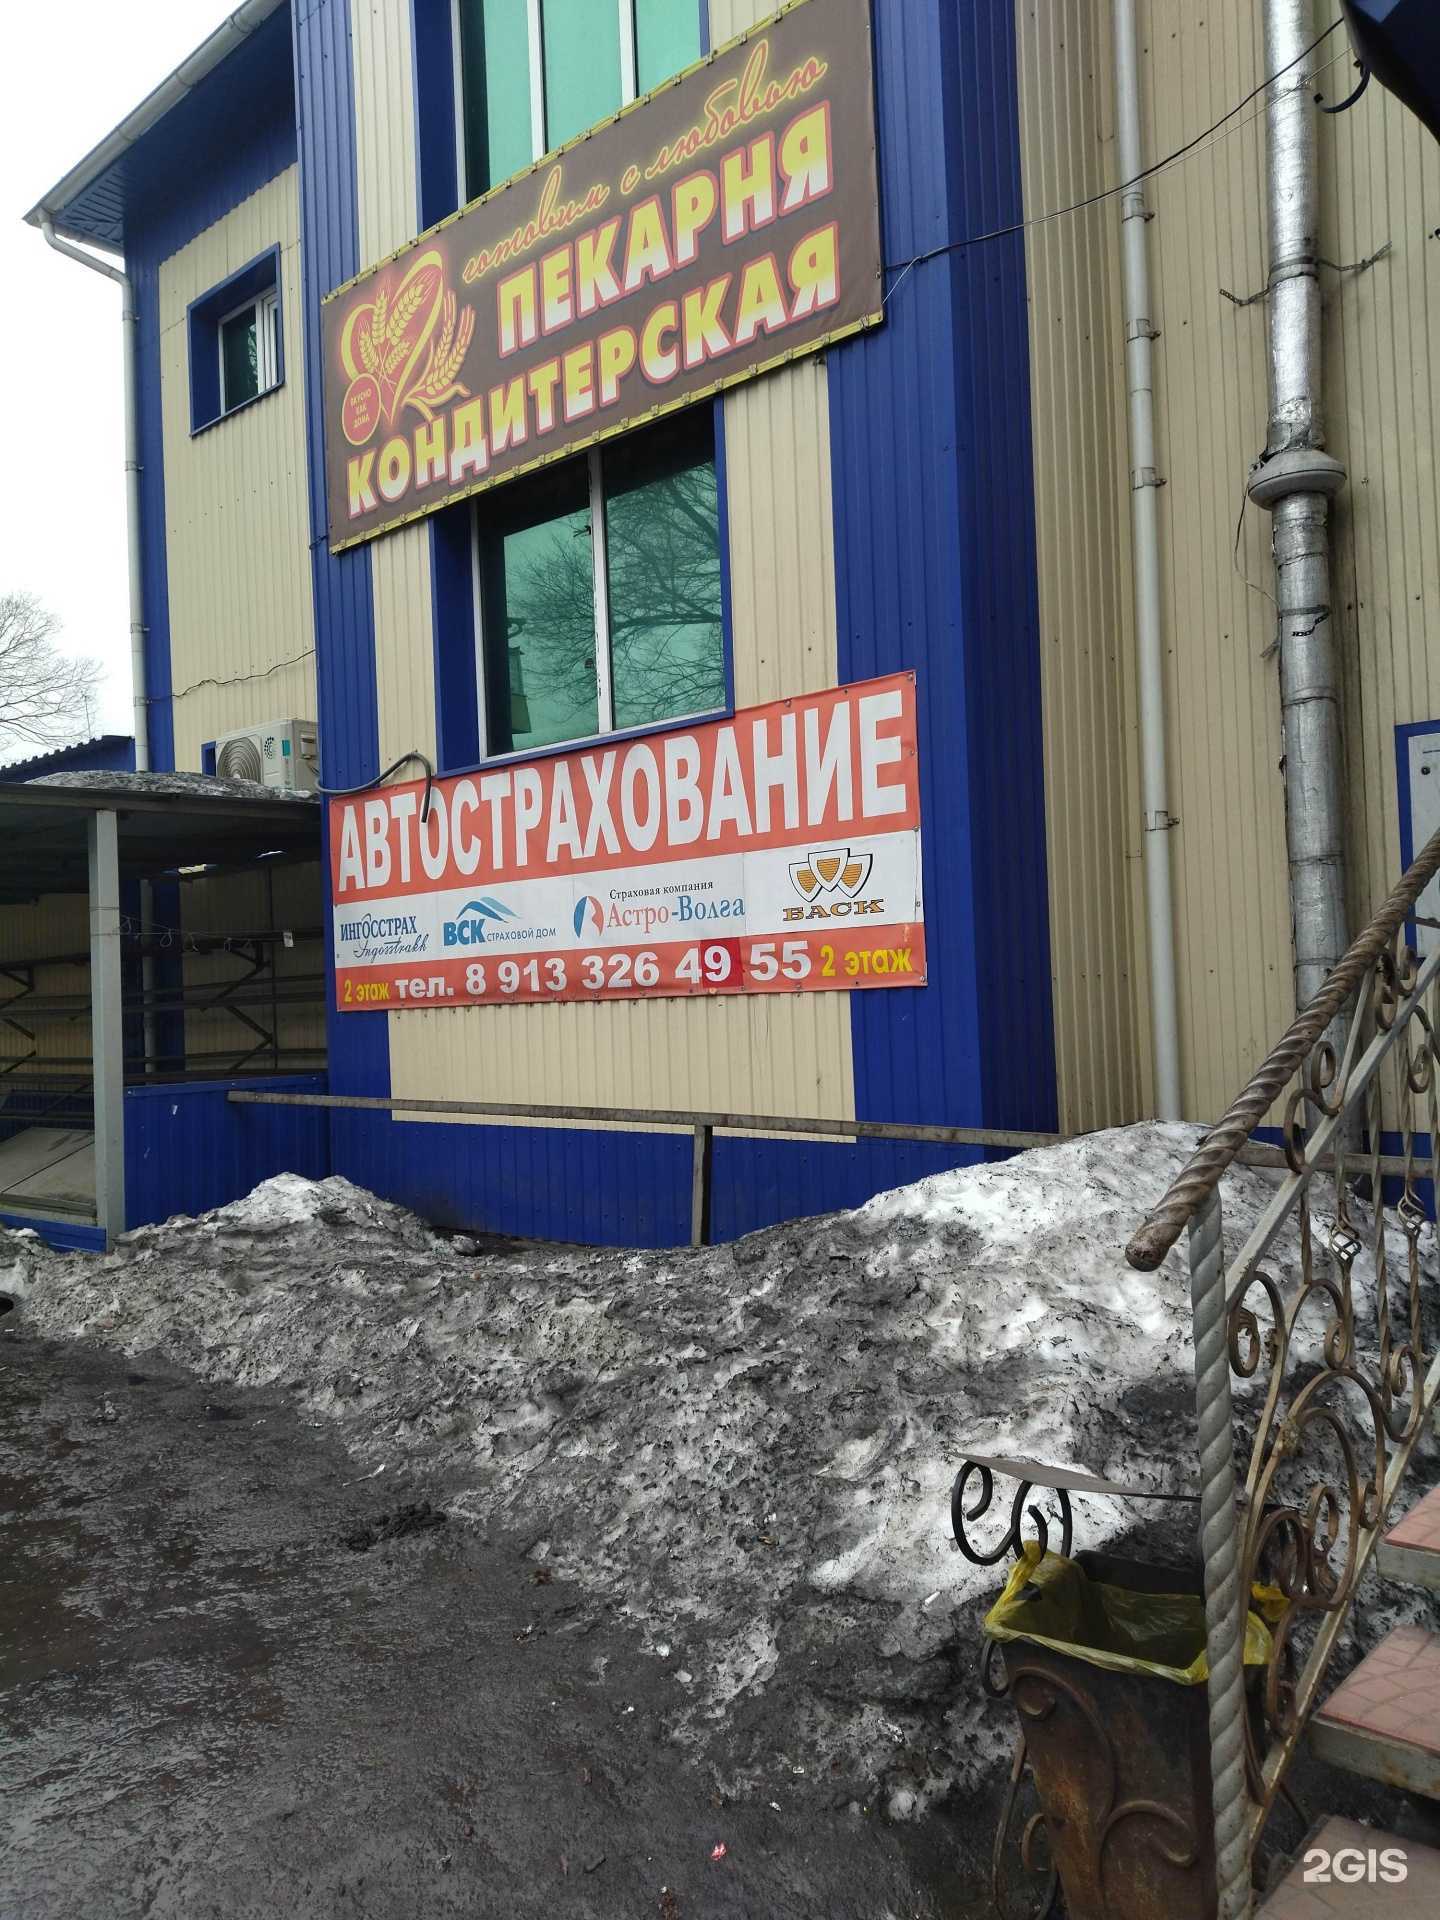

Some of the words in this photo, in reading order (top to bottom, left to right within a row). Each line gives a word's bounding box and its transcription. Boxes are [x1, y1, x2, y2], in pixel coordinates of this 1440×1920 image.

[463, 164, 610, 284] готовим
[620, 164, 642, 195] с
[645, 39, 828, 180] любовью
[498, 100, 834, 358] ПЕКАРНЯ
[348, 221, 838, 518] КОНДИТЕРСКАЯ
[338, 690, 907, 892] АВТОСТРАХОВАНИЕ
[609, 886, 660, 902] Страховая
[663, 880, 714, 894] компания
[340, 913, 417, 941] ИНГОССТРАХ
[607, 895, 745, 932] Астро-Волга
[782, 899, 885, 922] БАСК
[353, 934, 429, 963] Ingosstrakh
[443, 918, 486, 946] ВСК
[486, 926, 534, 942] СТРАХОВОЙ
[536, 927, 557, 939] ДОМ
[344, 979, 353, 1002] 2
[356, 982, 390, 1001] этаж
[395, 976, 454, 999] тел.
[465, 963, 487, 995] 8
[497, 957, 568, 994] 913
[581, 952, 660, 989] 326
[675, 945, 732, 984] 49
[750, 940, 812, 981] 55
[820, 945, 837, 977] 2
[844, 944, 914, 976] этаж
